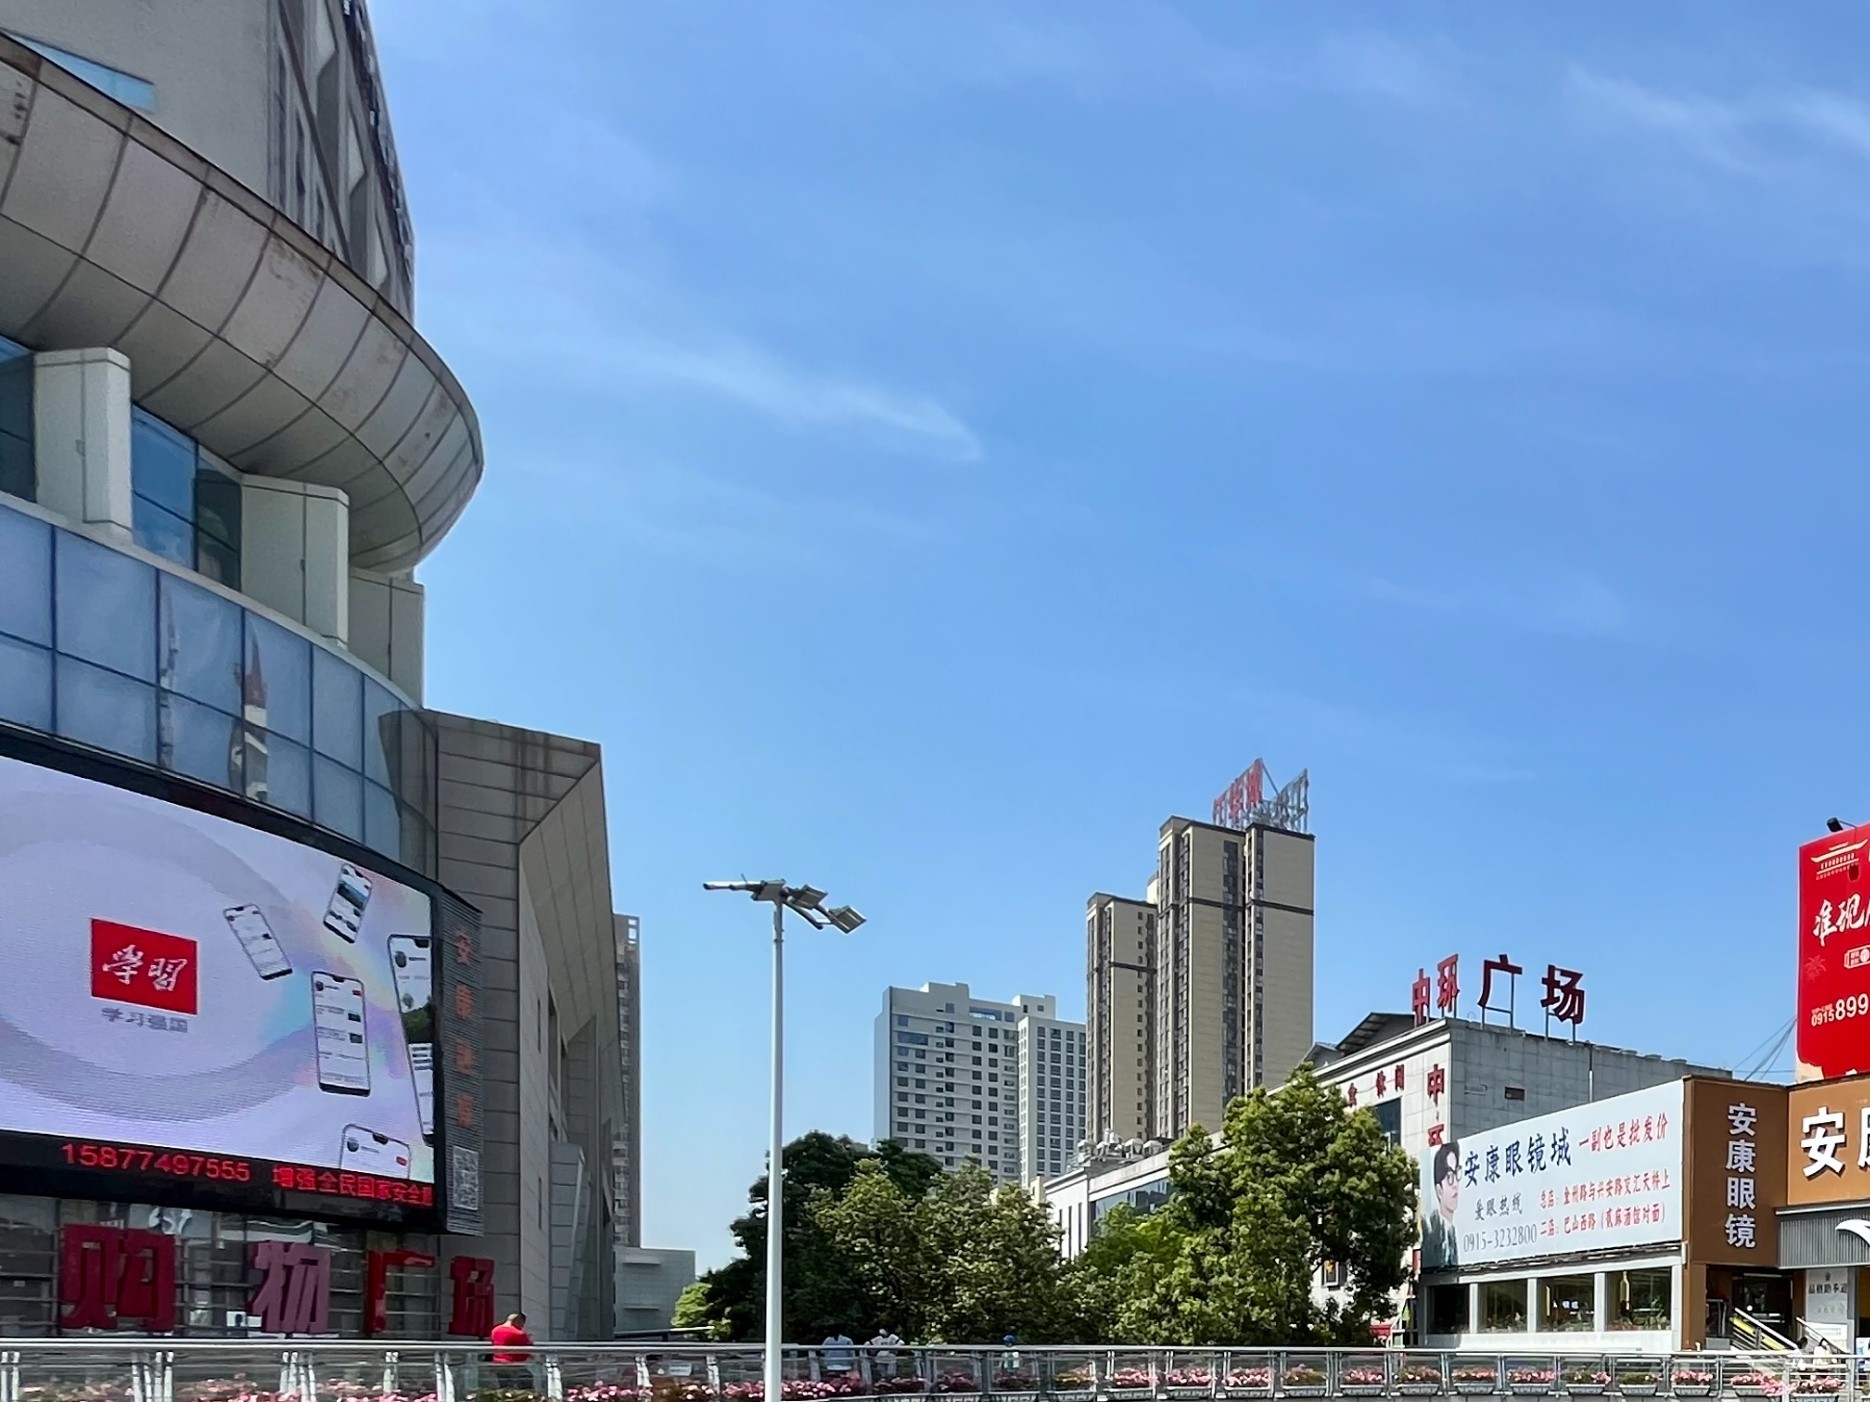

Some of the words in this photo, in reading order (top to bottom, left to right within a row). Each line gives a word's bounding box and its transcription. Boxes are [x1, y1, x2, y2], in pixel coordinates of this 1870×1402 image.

[1412, 953, 1586, 1027] 中环广场
[101, 1007, 188, 1033] 学习强国
[1811, 1008, 1835, 1028] 0915
[1835, 993, 1868, 1021] 899
[61, 1143, 250, 1182] 15877497555
[1463, 1126, 1572, 1188] 安康眼镜城
[1577, 1112, 1669, 1154] 一副也是批发价
[1725, 1102, 1757, 1249] 安康眼镜
[1474, 1194, 1524, 1221] 爱眼热线
[1463, 1223, 1537, 1253] 0915-3232800
[61, 1222, 495, 1336] 购物广场
